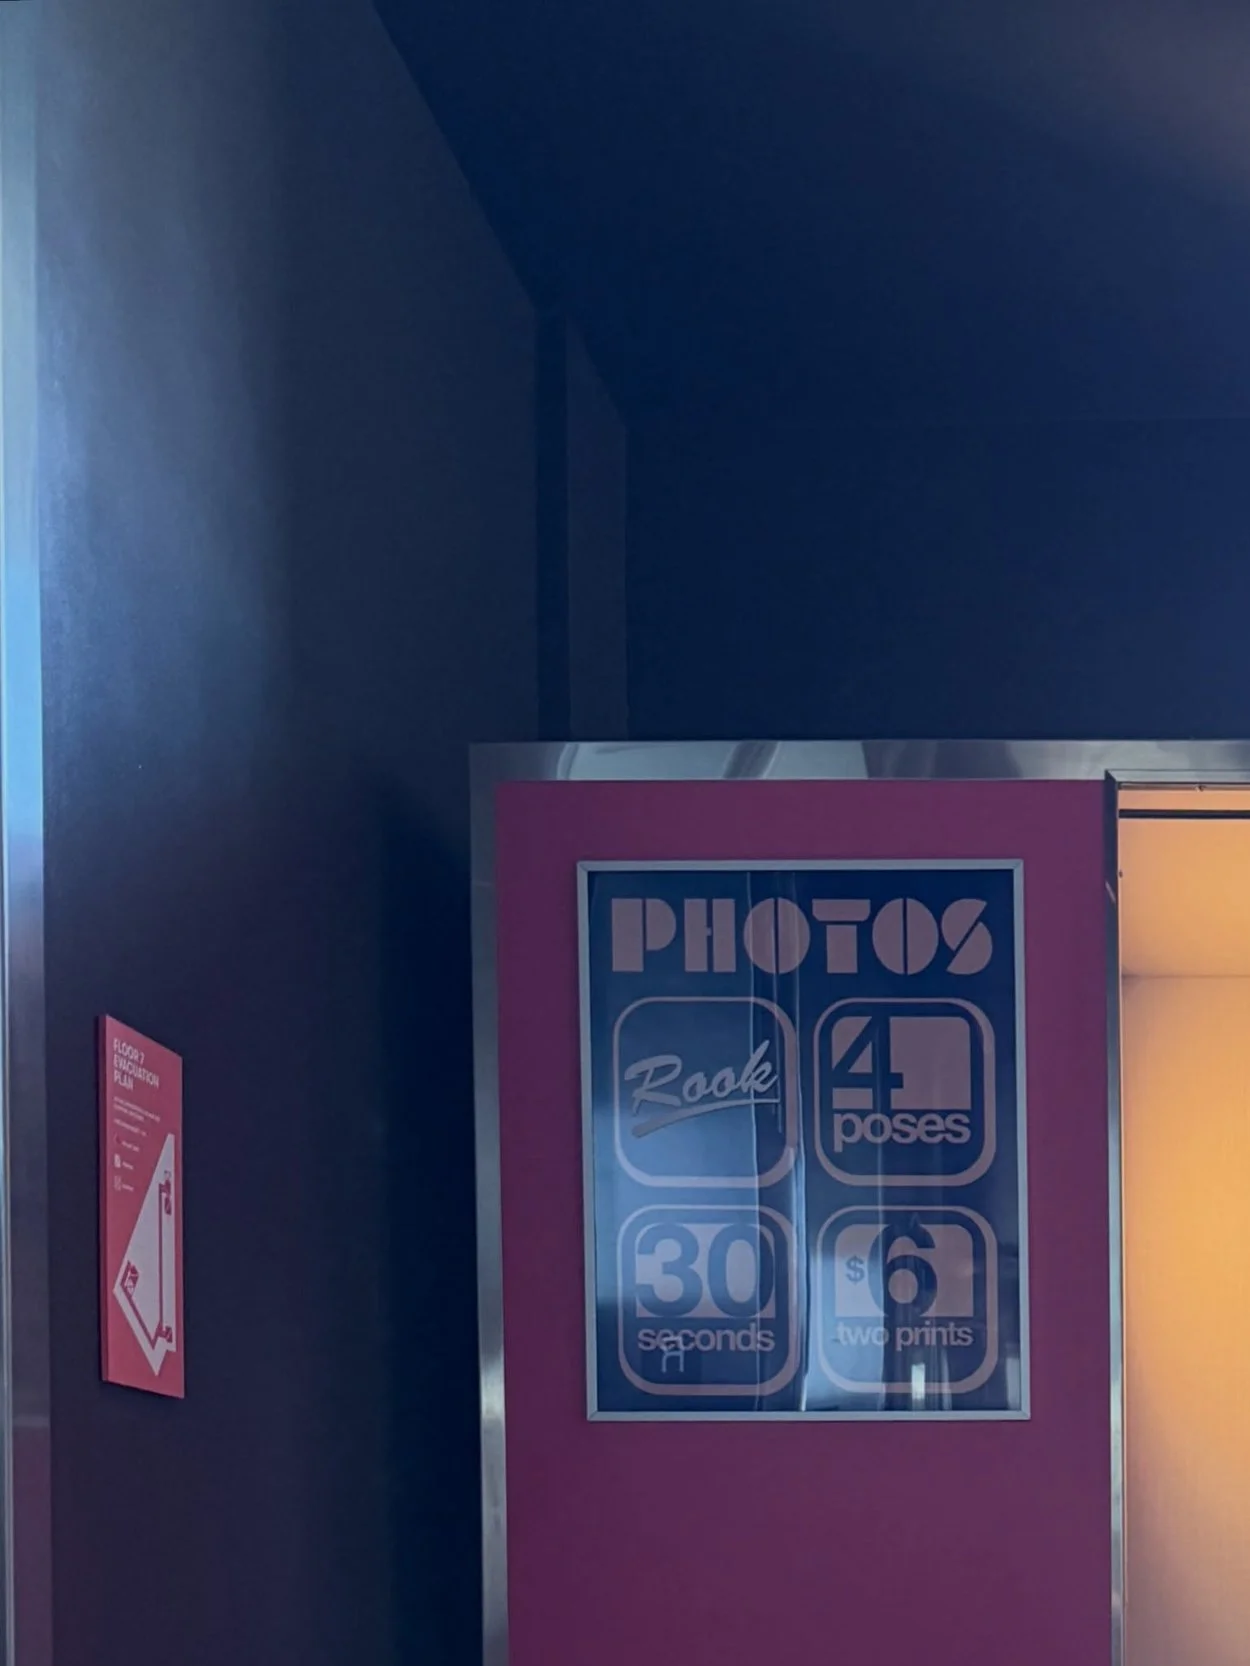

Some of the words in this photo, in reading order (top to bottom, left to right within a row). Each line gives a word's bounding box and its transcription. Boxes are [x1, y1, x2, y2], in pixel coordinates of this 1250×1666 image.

[611, 897, 993, 976] PHOTOS
[624, 1040, 778, 1114] Rook
[832, 1014, 904, 1111] 4
[833, 1113, 971, 1152] poses
[635, 1222, 774, 1319] 30
[637, 1322, 776, 1352] seconds
[835, 1322, 889, 1346] two
[895, 1320, 974, 1351] prints
